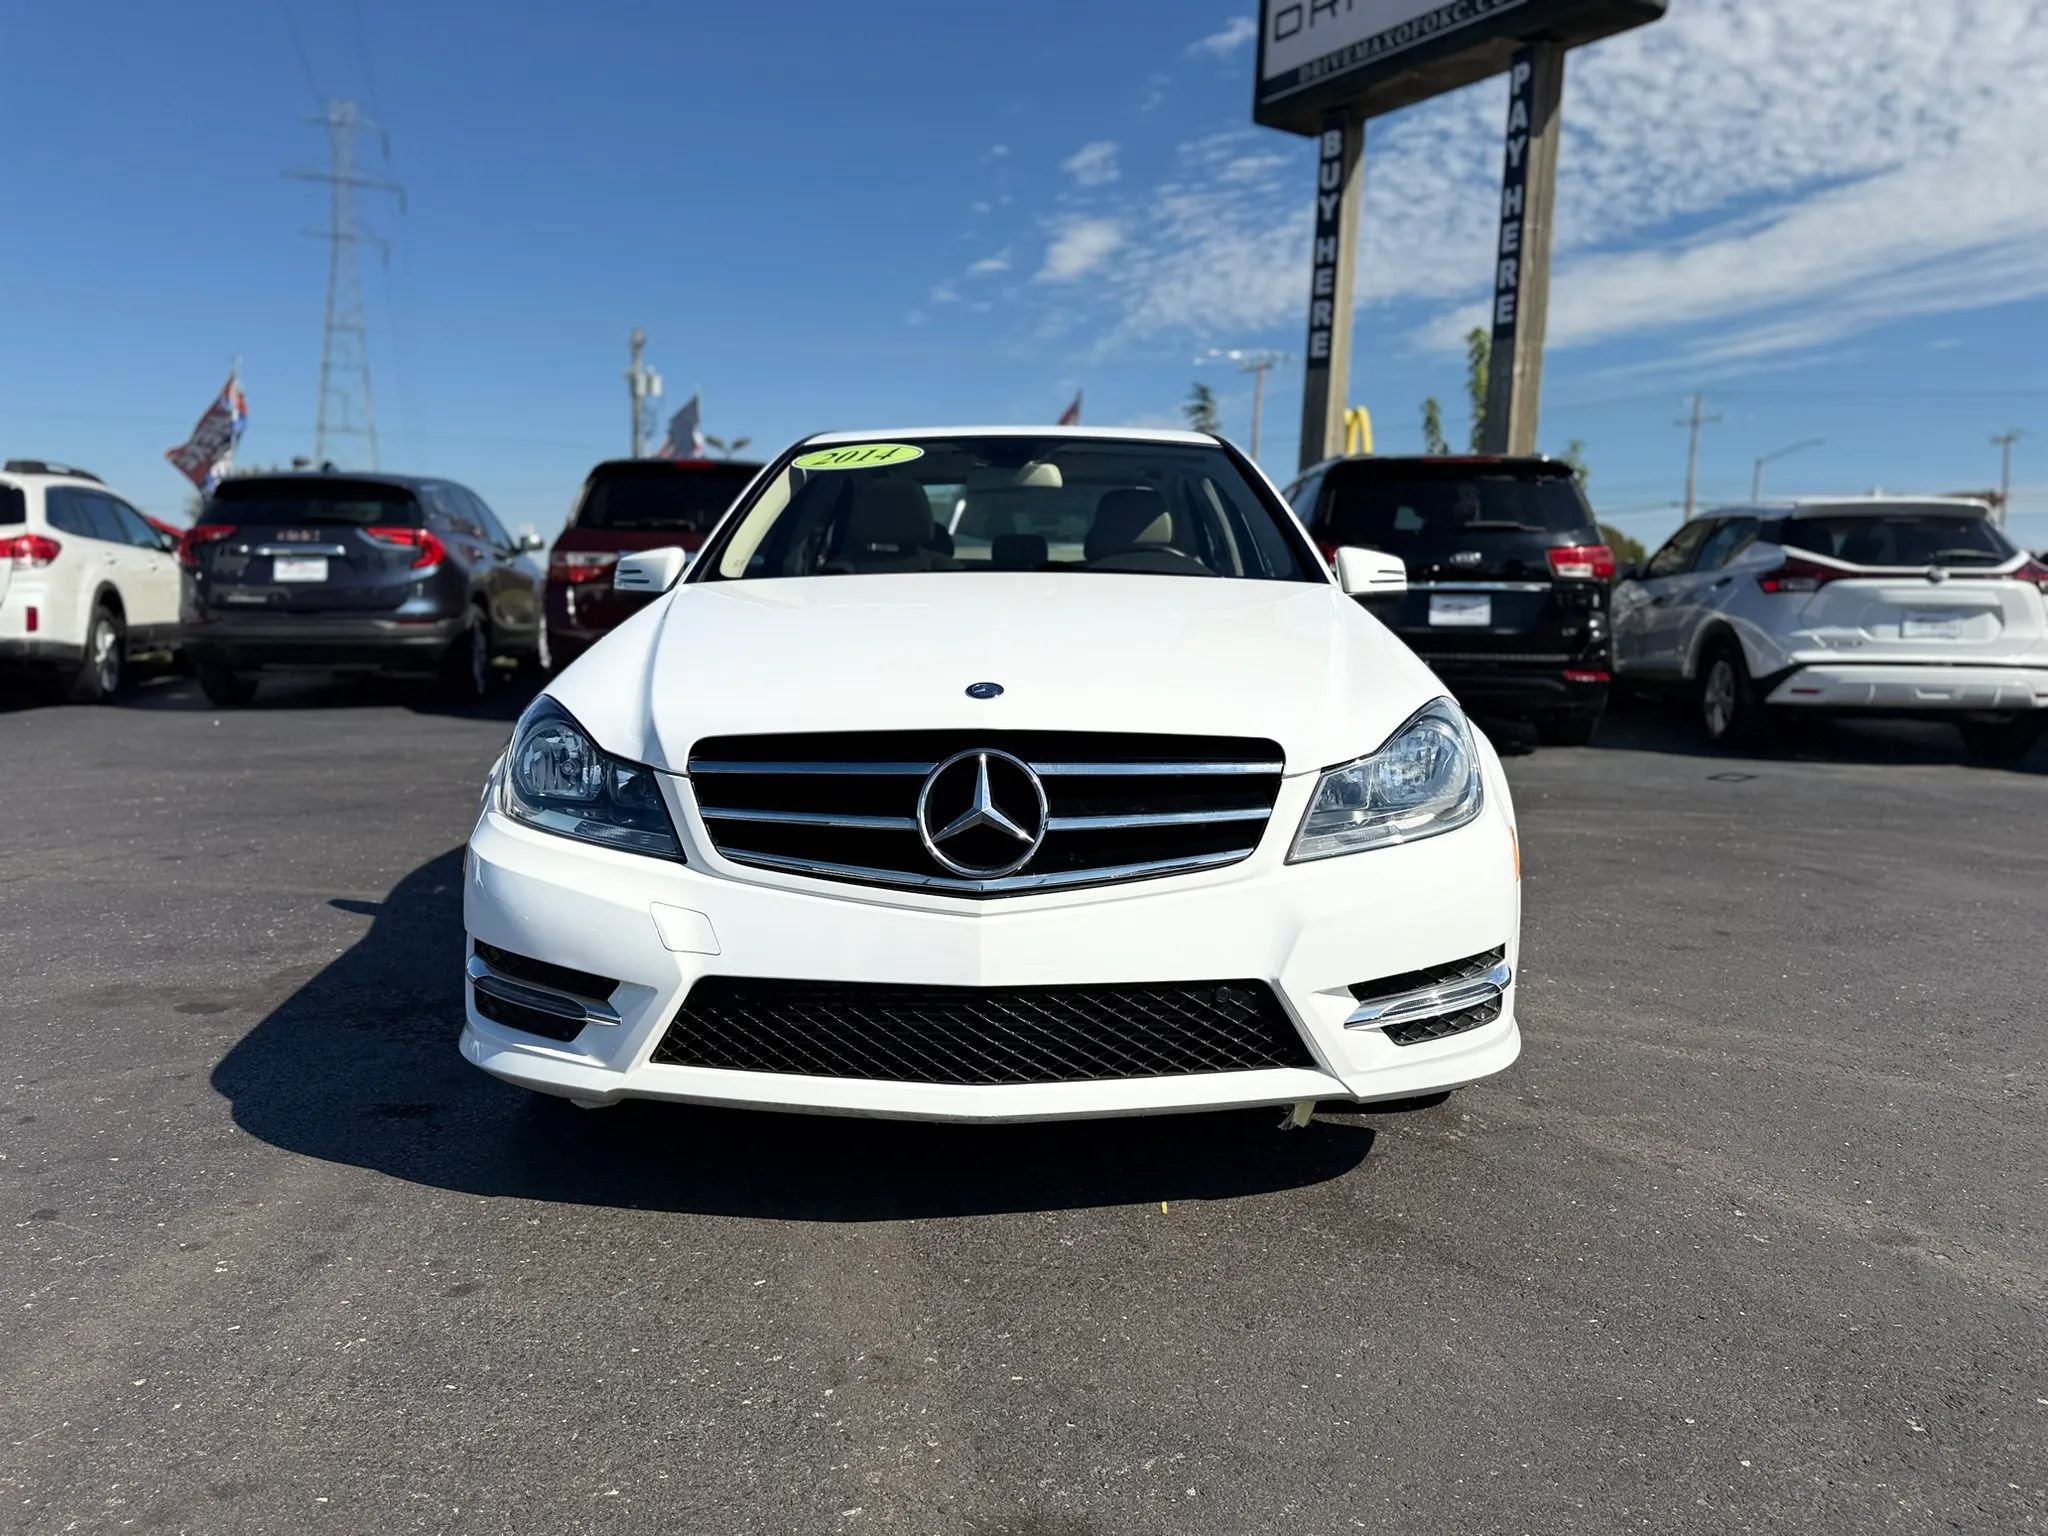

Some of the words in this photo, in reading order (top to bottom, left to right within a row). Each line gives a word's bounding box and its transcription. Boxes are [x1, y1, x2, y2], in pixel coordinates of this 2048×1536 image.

[1508, 61, 1531, 167] PAY
[1319, 129, 1342, 221] BUY
[1310, 237, 1336, 358] HERE
[1497, 184, 1524, 324] HERE
[810, 447, 902, 466] 2014
